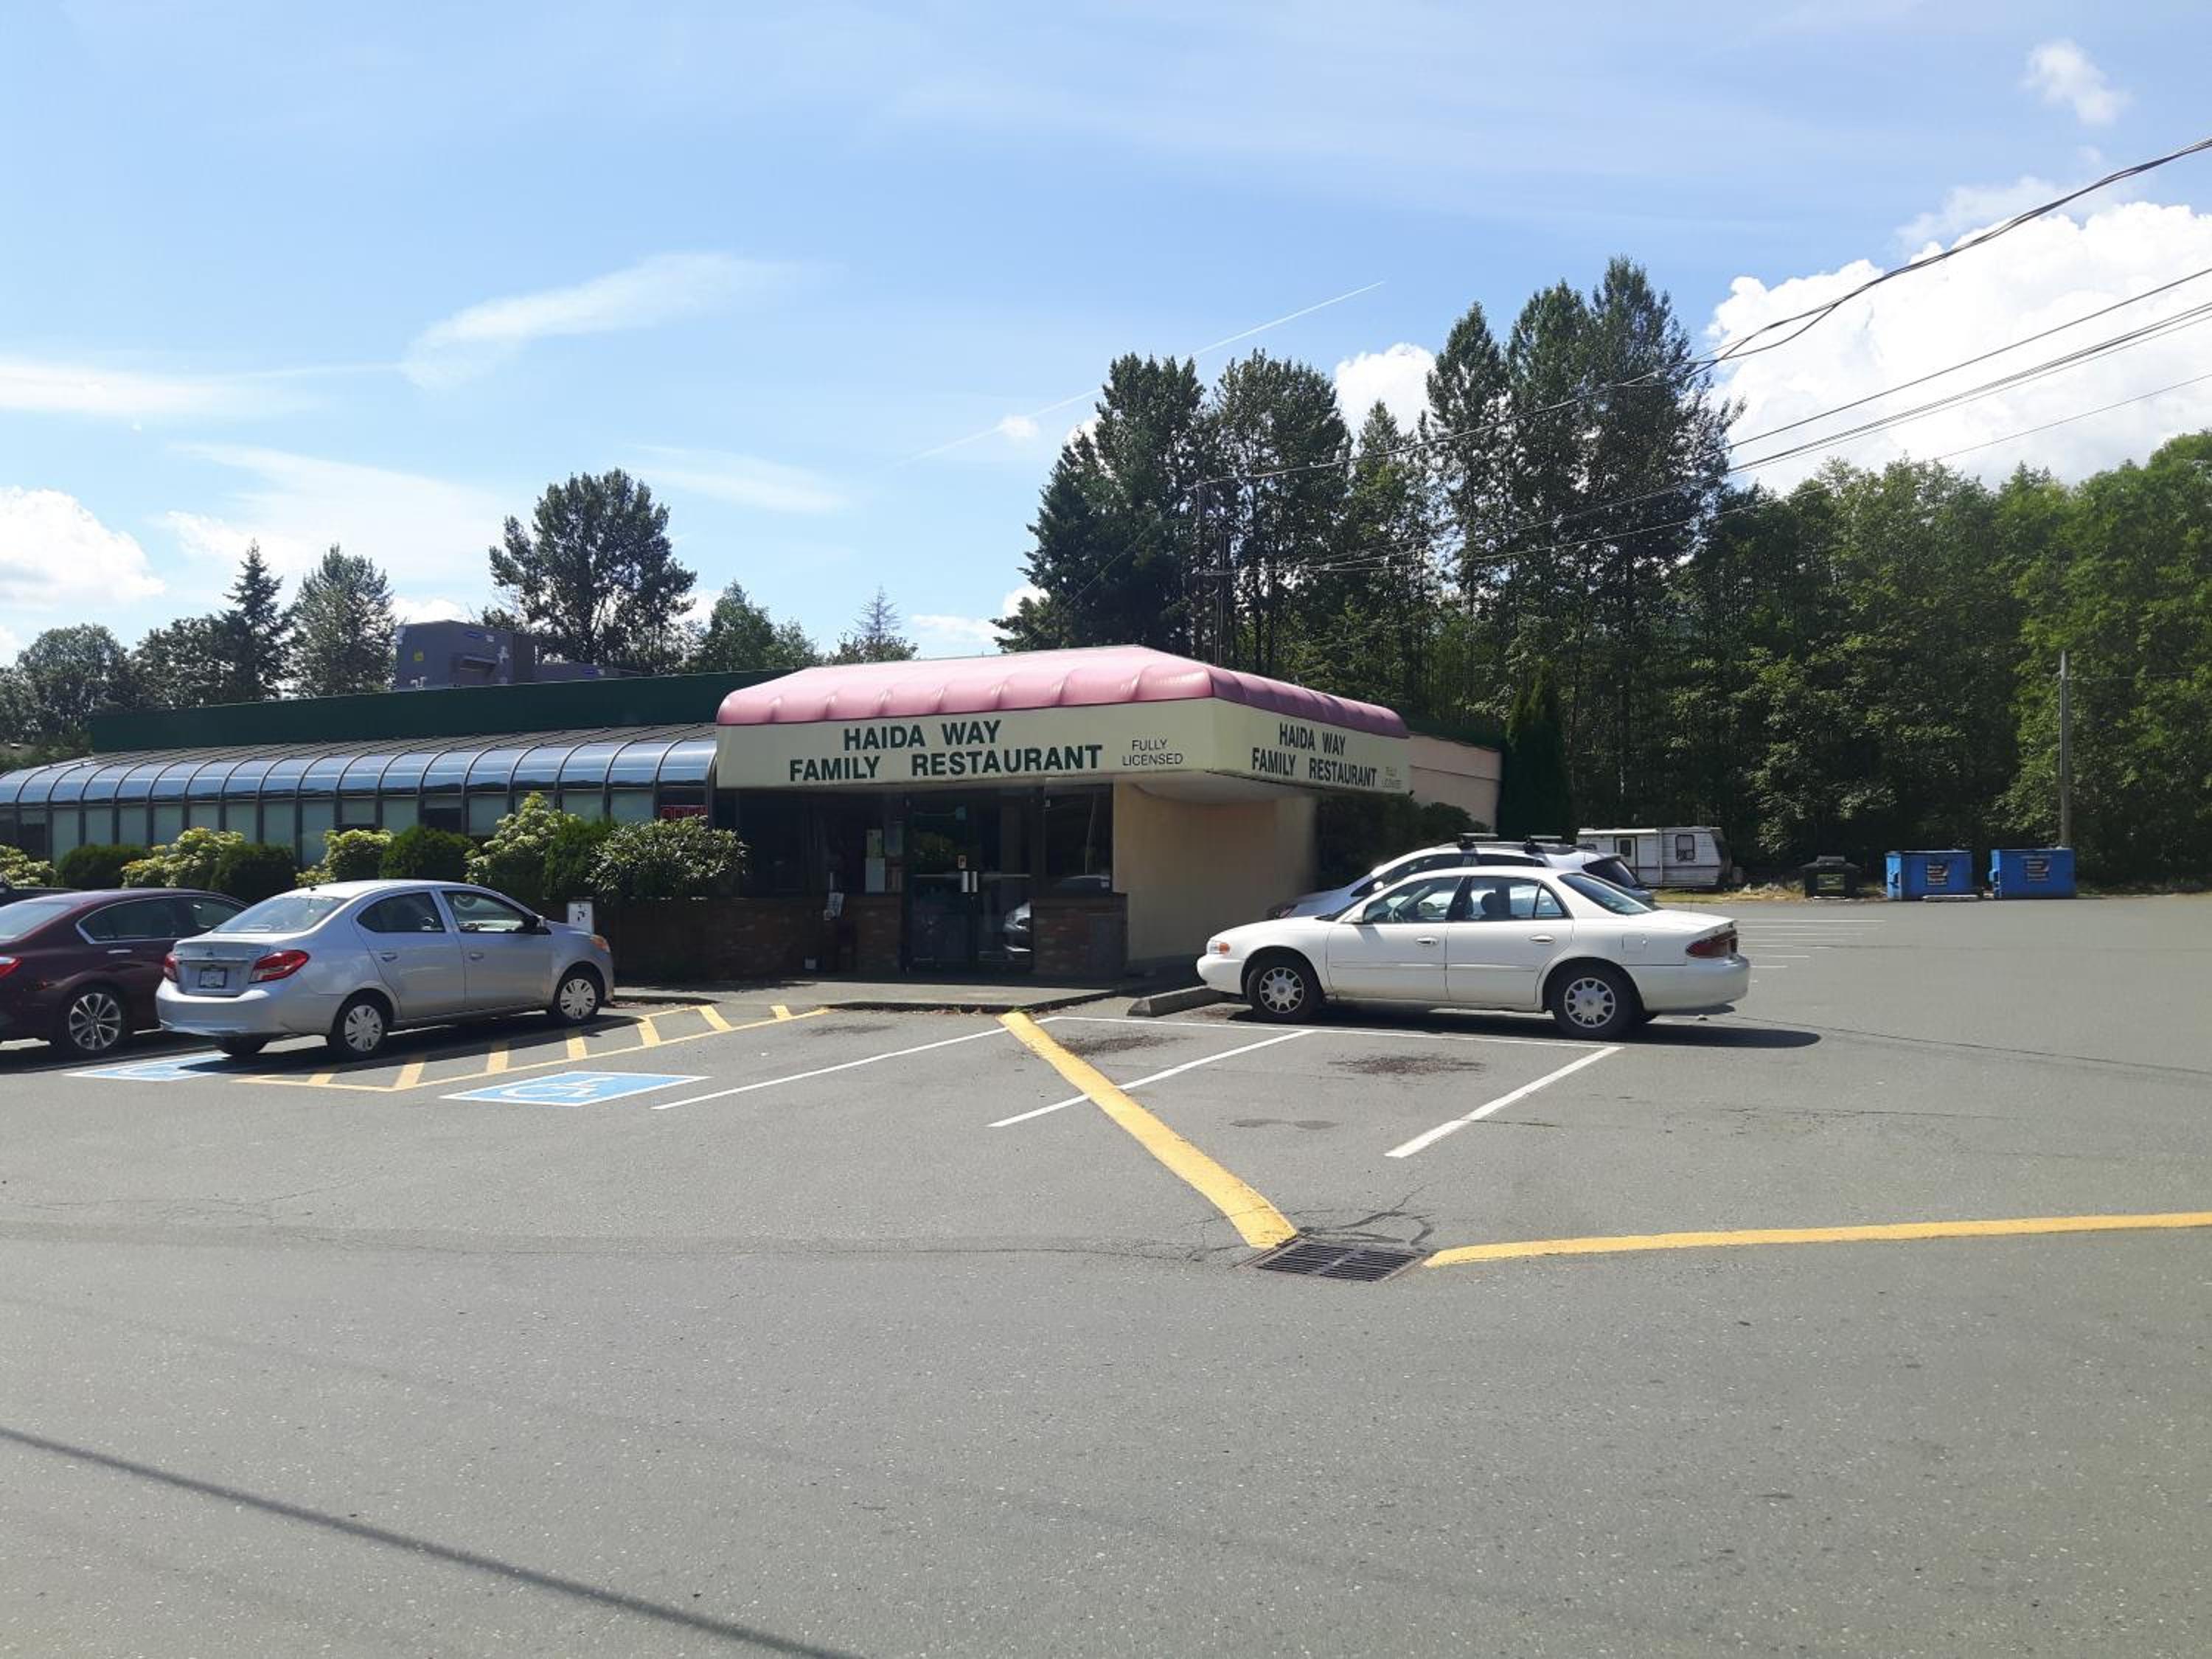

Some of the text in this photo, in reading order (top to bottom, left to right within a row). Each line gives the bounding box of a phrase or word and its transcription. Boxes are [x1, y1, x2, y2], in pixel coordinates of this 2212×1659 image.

[844, 720, 1002, 751] HAIDA WAY
[1132, 739, 1168, 751] FULLY
[1279, 723, 1346, 756] HAIDA WAY
[789, 745, 1103, 782] FAMILY RESTAURANT
[1122, 752, 1183, 766] LICENSED
[1252, 748, 1296, 775] FAMILY
[1309, 757, 1377, 787] RESTAURANT
